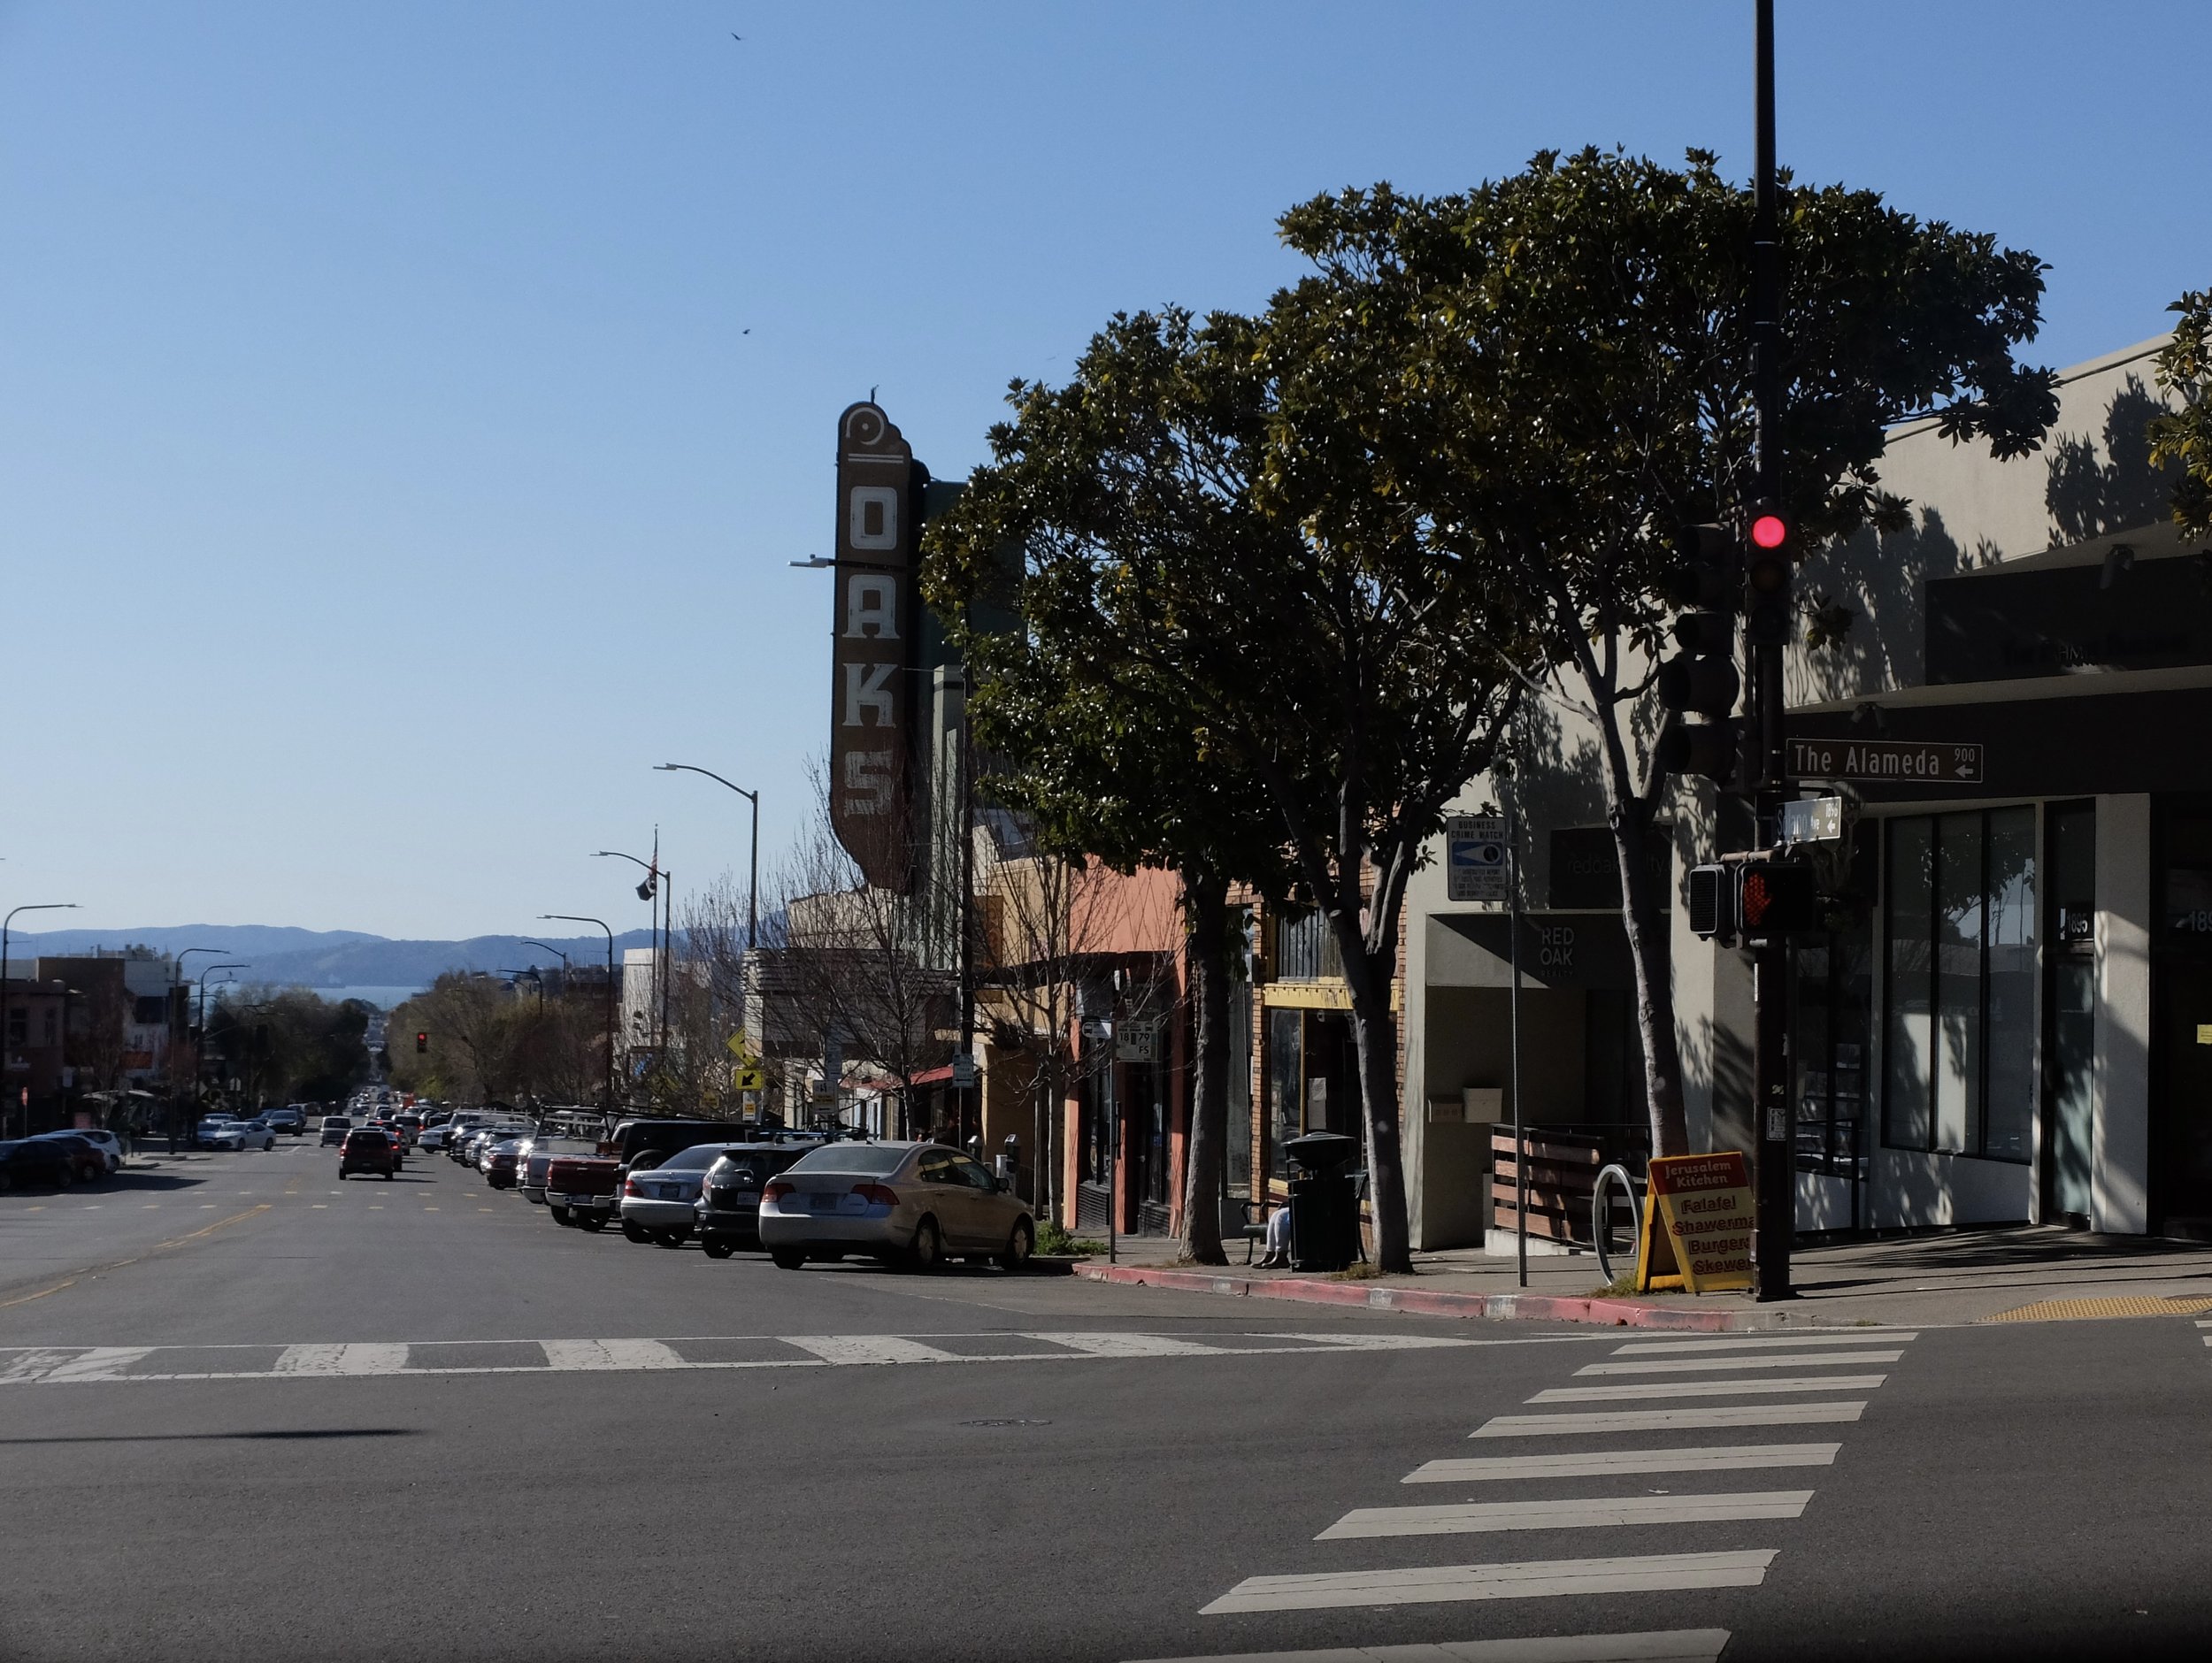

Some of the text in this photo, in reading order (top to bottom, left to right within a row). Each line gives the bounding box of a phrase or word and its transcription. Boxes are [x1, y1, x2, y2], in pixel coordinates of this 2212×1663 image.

[841, 485, 901, 817] OAKS
[1794, 744, 1976, 776] The Alameda 900
[1458, 820, 1496, 829] BUSINESS
[1777, 807, 1808, 836] Solano
[1451, 831, 1503, 839] CRIME WATCH
[2067, 912, 2088, 933] 1895
[1541, 926, 1575, 945] RED
[1540, 946, 1573, 966] OAK
[1120, 1032, 1129, 1042] 18
[1139, 1032, 1149, 1042] 79
[1665, 1161, 1732, 1179] Jerusalem
[1676, 1174, 1728, 1188] Kitchen
[1681, 1195, 1736, 1214] Falafel
